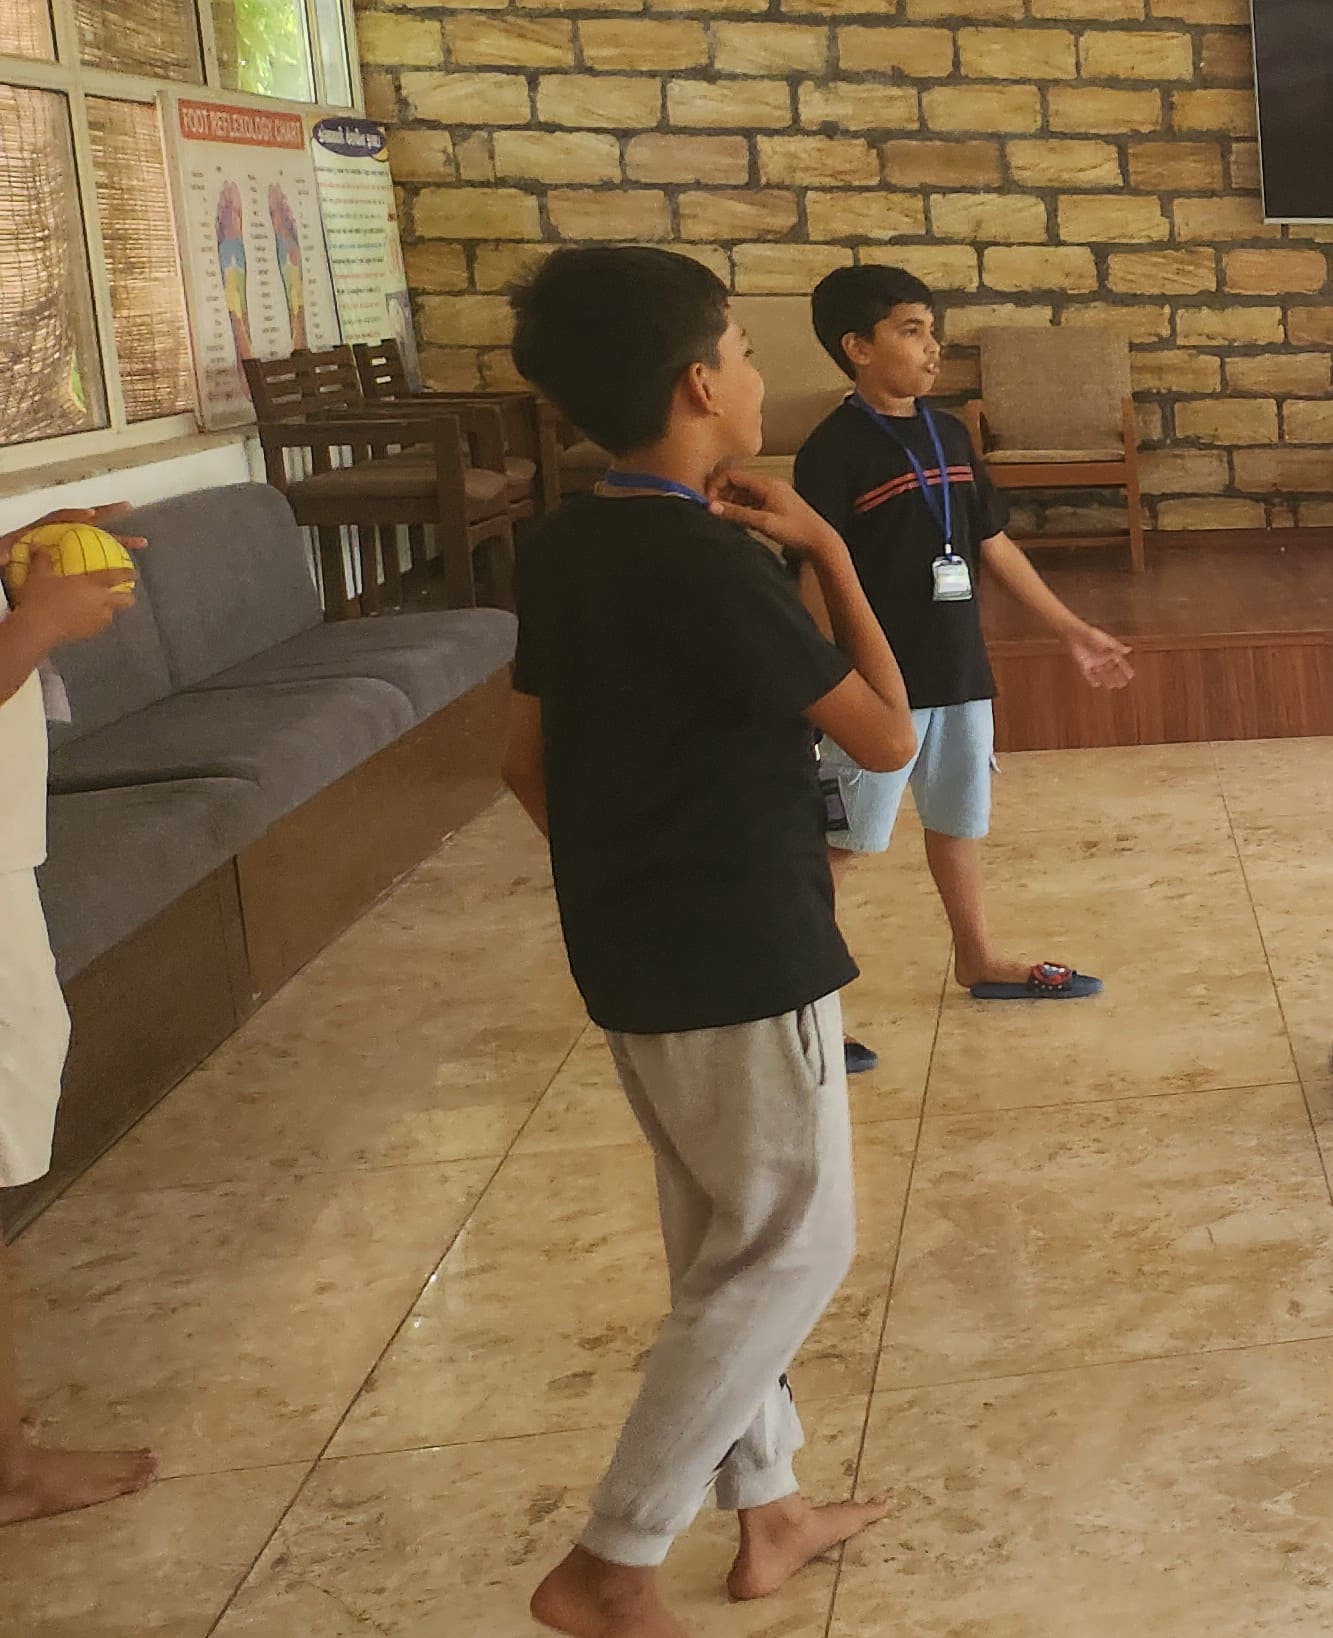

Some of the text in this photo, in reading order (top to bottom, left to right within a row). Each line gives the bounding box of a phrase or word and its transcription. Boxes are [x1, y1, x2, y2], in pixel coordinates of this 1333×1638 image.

[182, 108, 209, 135] FOOT
[210, 111, 273, 141] REFLEXOLOGY
[274, 119, 302, 144] CHART
